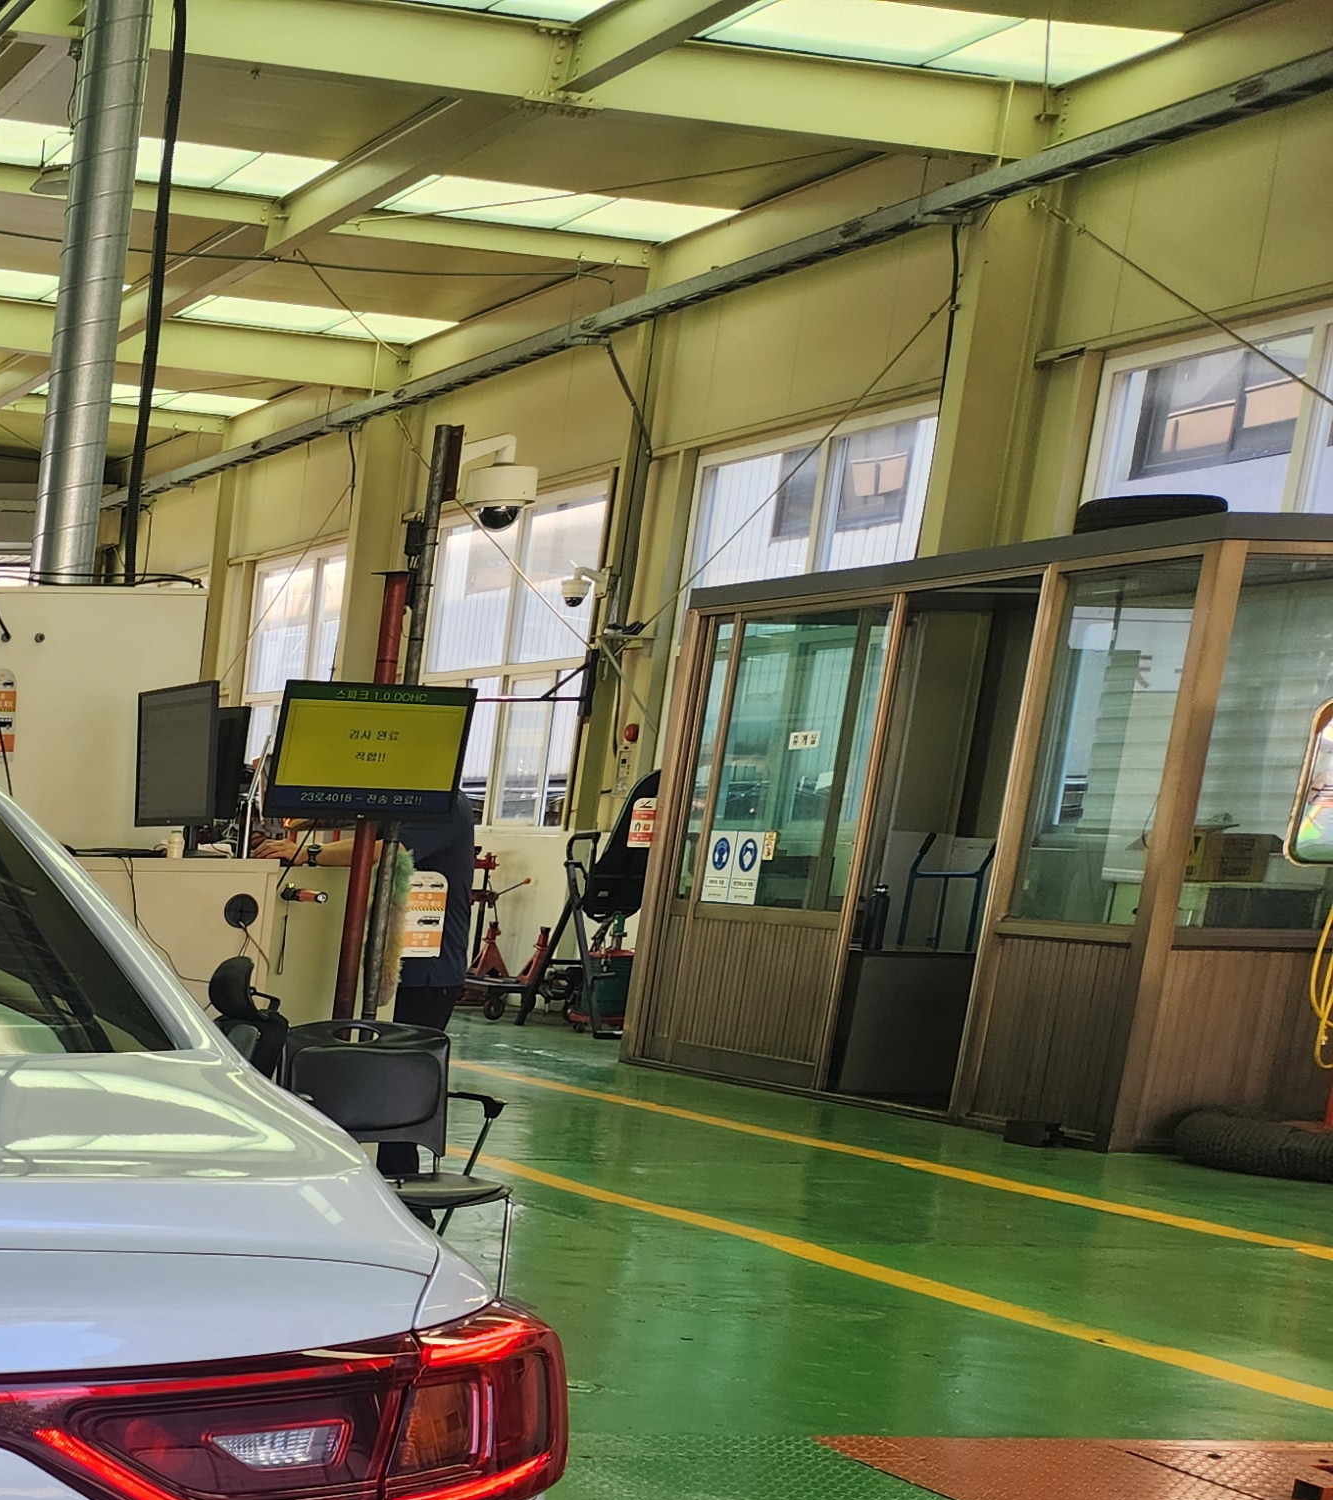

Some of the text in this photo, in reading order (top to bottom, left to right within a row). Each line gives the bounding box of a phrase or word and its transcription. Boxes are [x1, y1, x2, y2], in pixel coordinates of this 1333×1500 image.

[336, 689, 428, 703] 스파크 1.0 DOHC
[349, 729, 400, 741] 검사 완료
[792, 733, 818, 746] 휴게실
[355, 751, 386, 762] 적합!!
[300, 792, 352, 803] 23로4018
[366, 794, 389, 805] 전송
[393, 795, 422, 806] 완료!!
